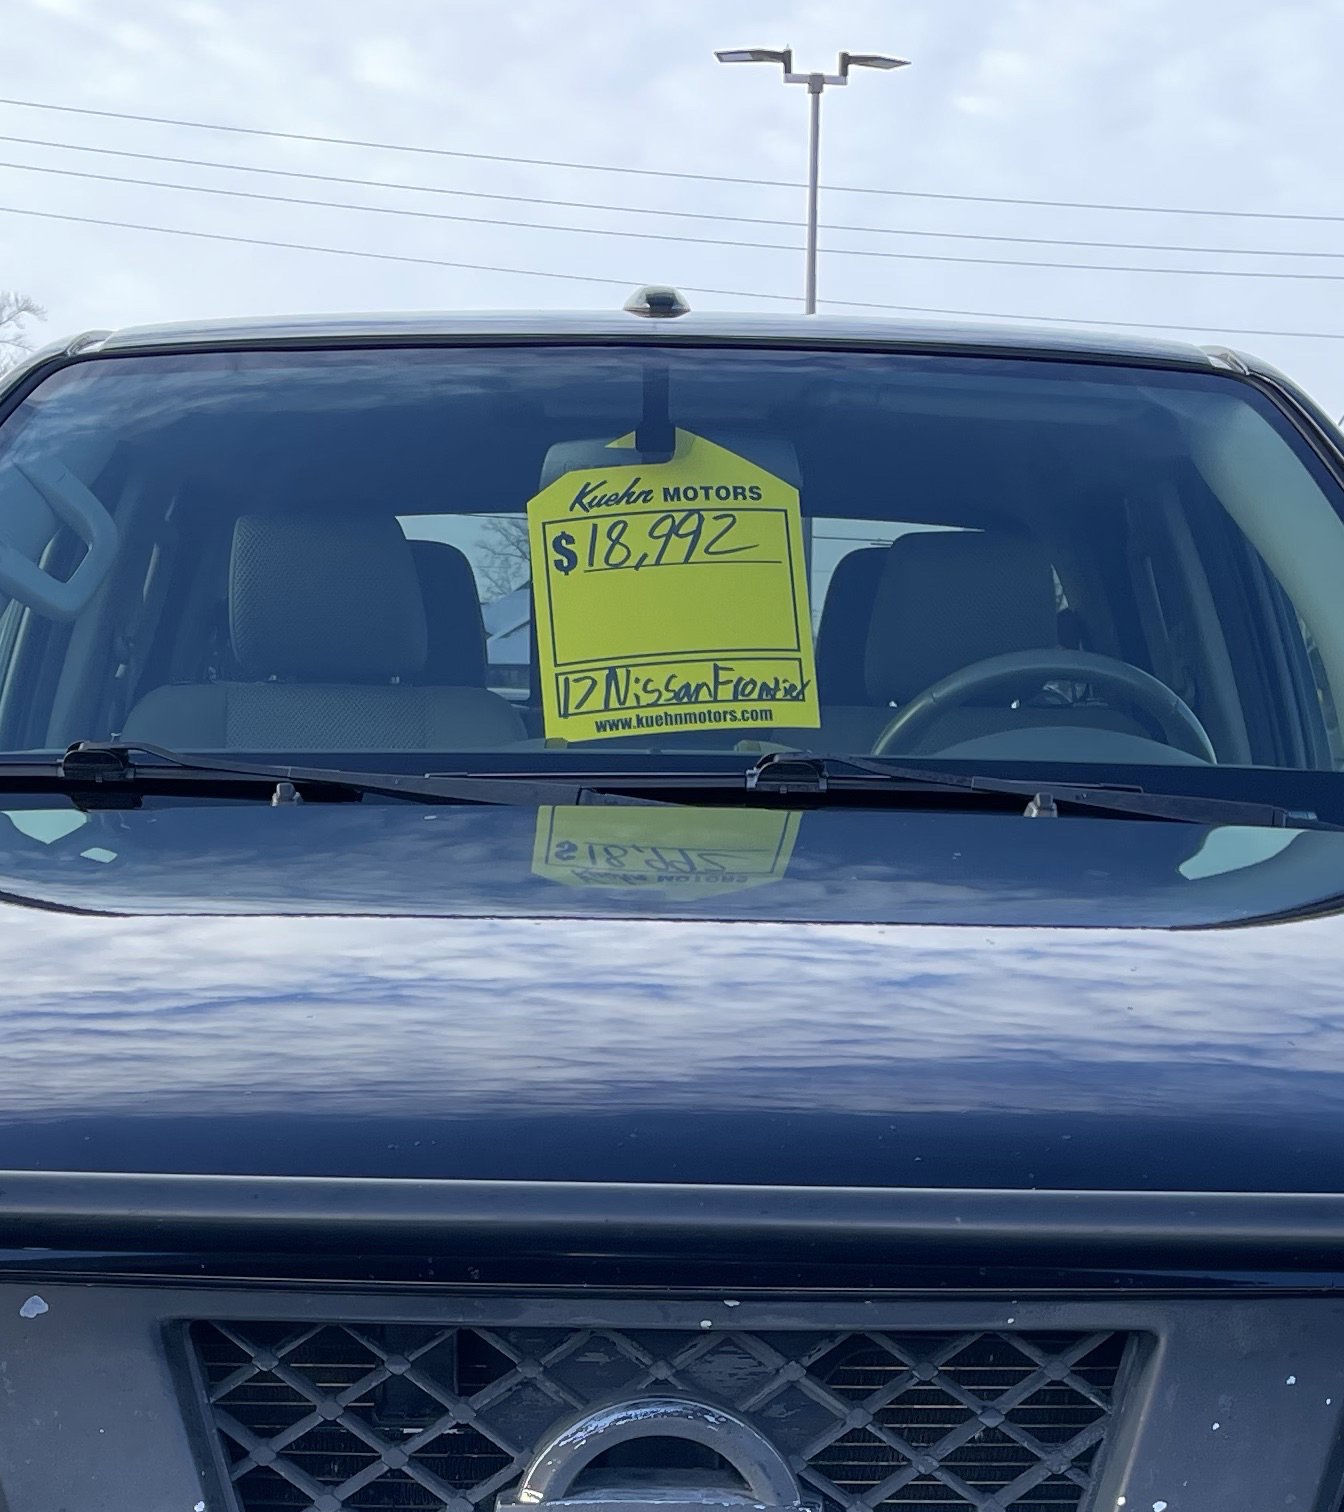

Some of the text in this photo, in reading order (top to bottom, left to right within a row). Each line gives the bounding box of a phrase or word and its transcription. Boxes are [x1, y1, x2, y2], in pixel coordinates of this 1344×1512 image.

[569, 477, 762, 512] Kuehn MOTORS
[604, 666, 713, 710] Nissan
[594, 708, 773, 733] www.kuehnmotors.com
